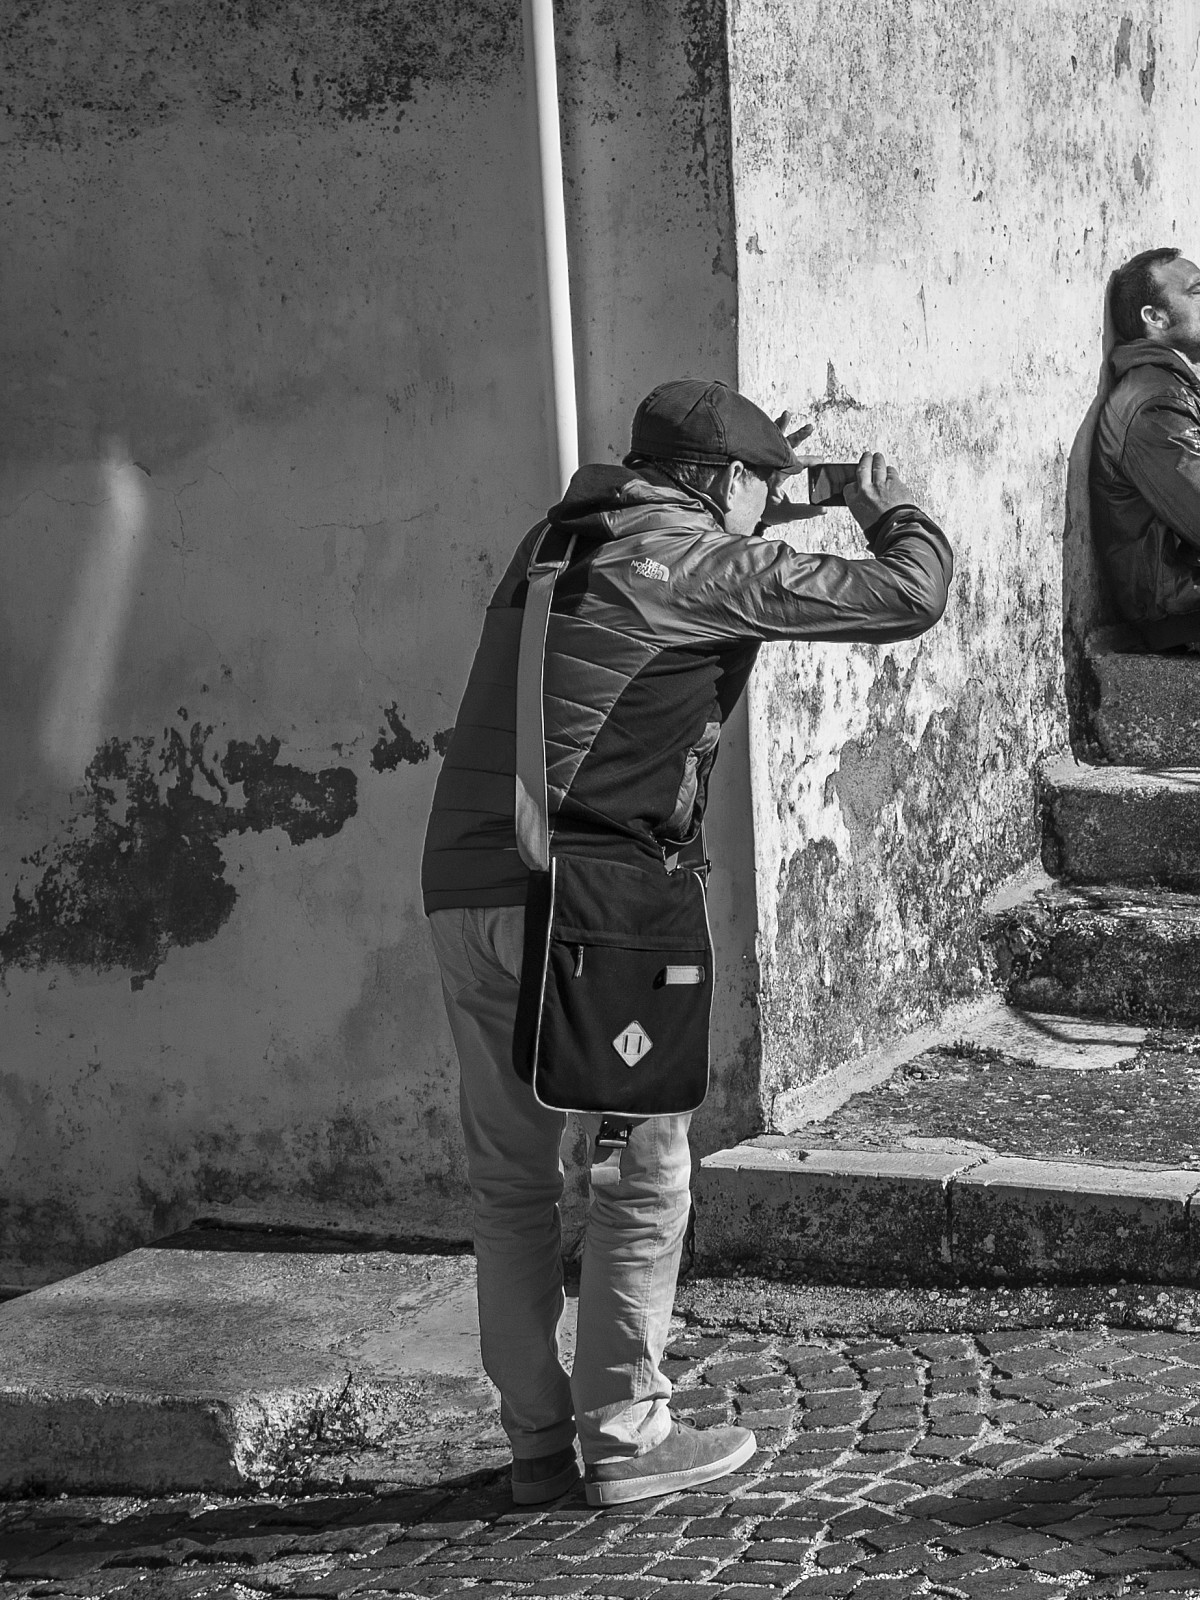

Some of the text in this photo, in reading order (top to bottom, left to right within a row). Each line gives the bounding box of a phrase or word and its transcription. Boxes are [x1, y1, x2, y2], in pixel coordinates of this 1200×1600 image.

[630, 559, 658, 574] NORTH
[645, 557, 660, 567] THE
[635, 565, 655, 579] FACE
